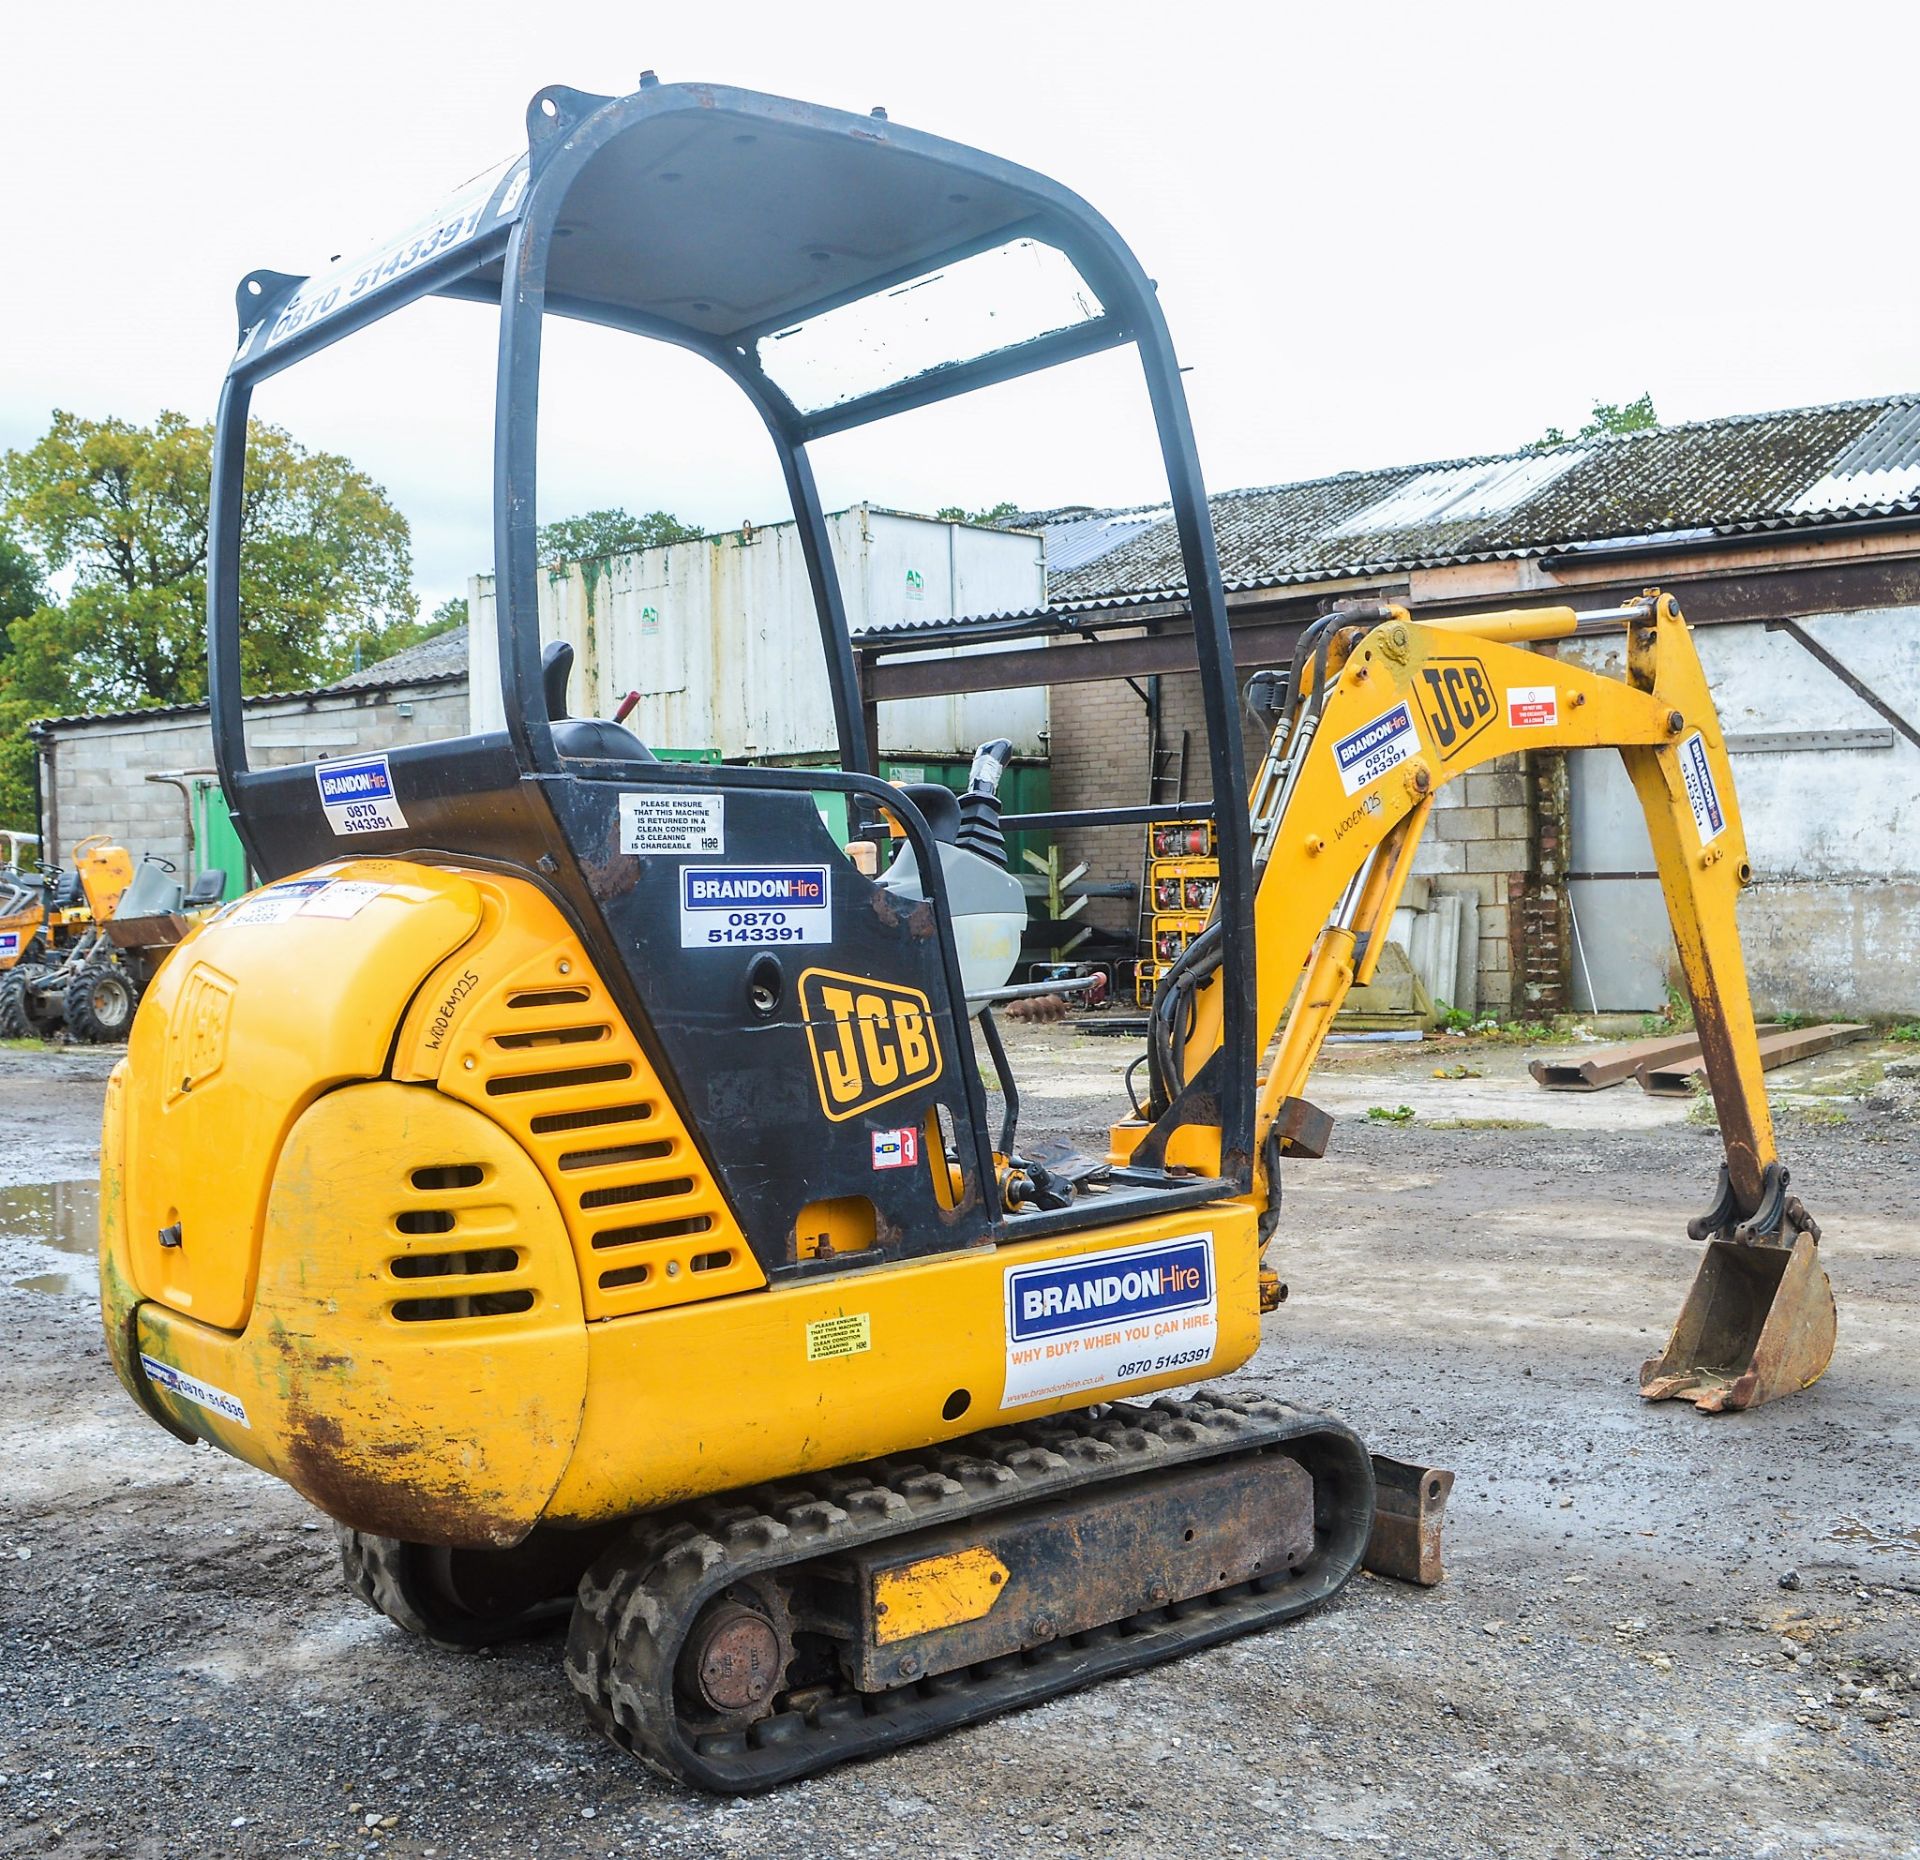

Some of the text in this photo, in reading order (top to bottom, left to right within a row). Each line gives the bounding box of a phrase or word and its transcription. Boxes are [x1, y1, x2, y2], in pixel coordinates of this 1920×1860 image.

[271, 206, 482, 341] 0870 5143391
[1422, 668, 1491, 747] JCB
[1358, 748, 1407, 786] 5143391
[1365, 745, 1394, 768] 0870
[346, 804, 377, 818] 0870
[640, 800, 670, 808] PLEASE
[344, 816, 393, 832] 5143391
[728, 912, 786, 926] 0870
[708, 927, 803, 943] 5143391
[821, 986, 930, 1102] JCB
[1011, 1313, 1213, 1365] WHY BUY? WHEN YOU CAN HIRE.
[1117, 1347, 1211, 1378] 0870 5143391
[180, 1380, 205, 1400] 0870
[1007, 1374, 1105, 1402] www.brandonhire.co.uk
